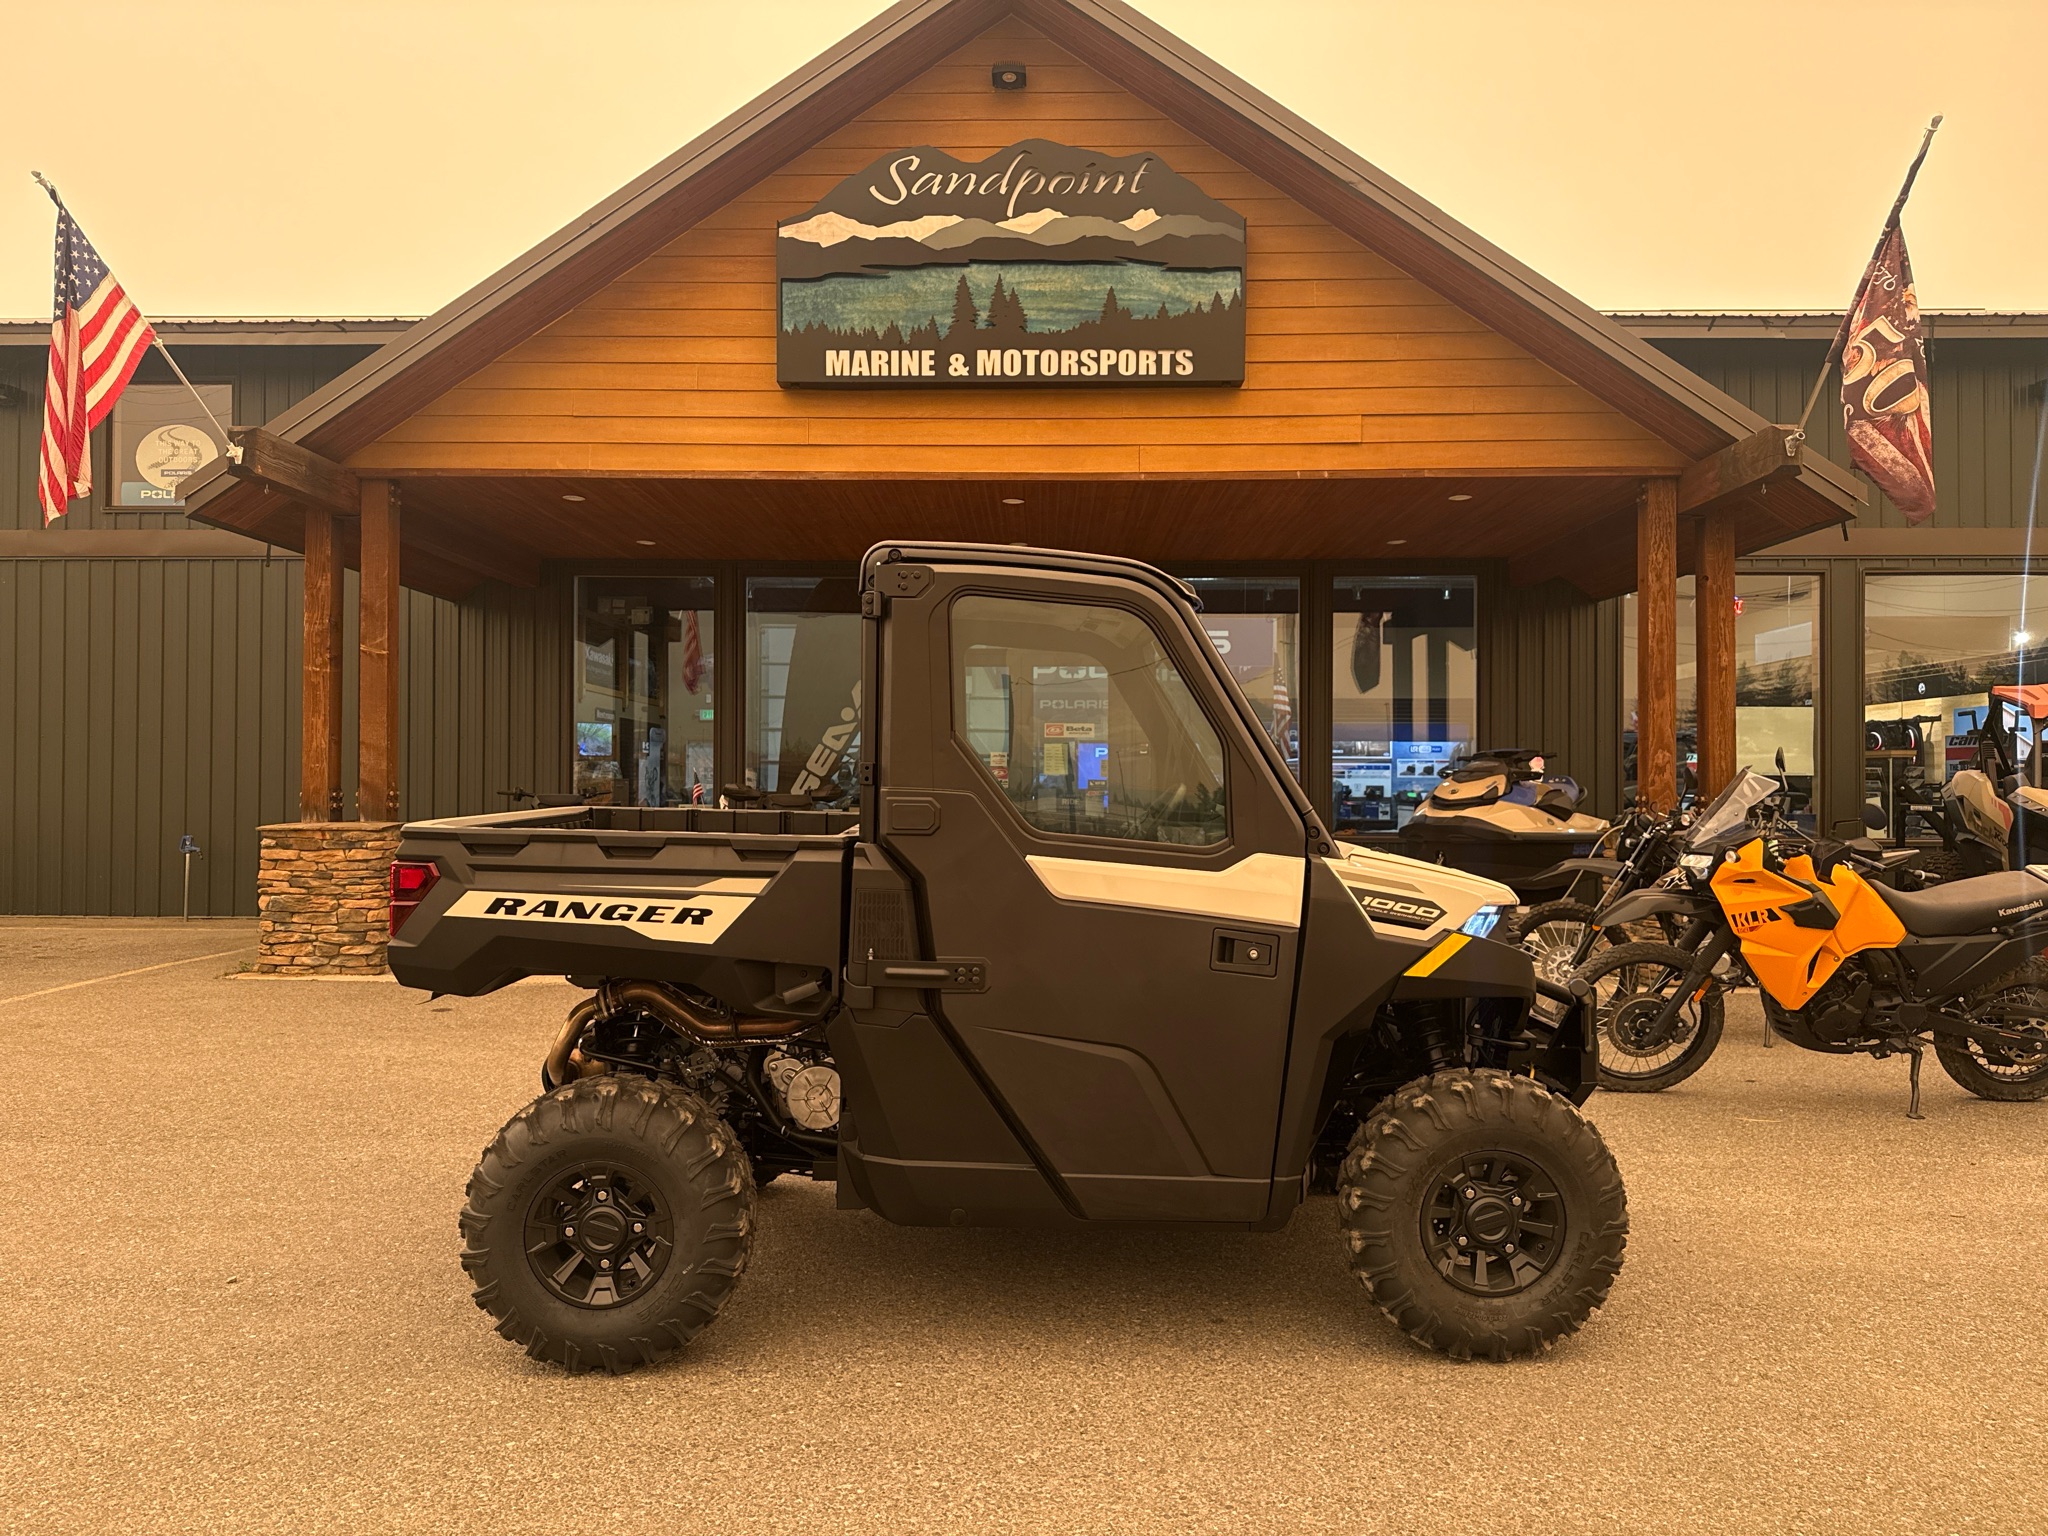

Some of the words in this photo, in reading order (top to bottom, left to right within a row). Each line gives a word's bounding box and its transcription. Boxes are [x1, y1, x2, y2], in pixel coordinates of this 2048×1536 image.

[869, 150, 1154, 218] Sandpoint
[825, 349, 936, 377] MARINE
[948, 352, 970, 377] &
[976, 349, 1195, 377] MOTORSPORTS
[483, 896, 714, 926] RANGER
[1361, 895, 1441, 919] 1000
[1732, 907, 1772, 928] KLR
[1997, 898, 2044, 917] Kawasaki
[506, 1149, 568, 1213] CARLSTAR
[1540, 1231, 1590, 1307] CARLSTAR
